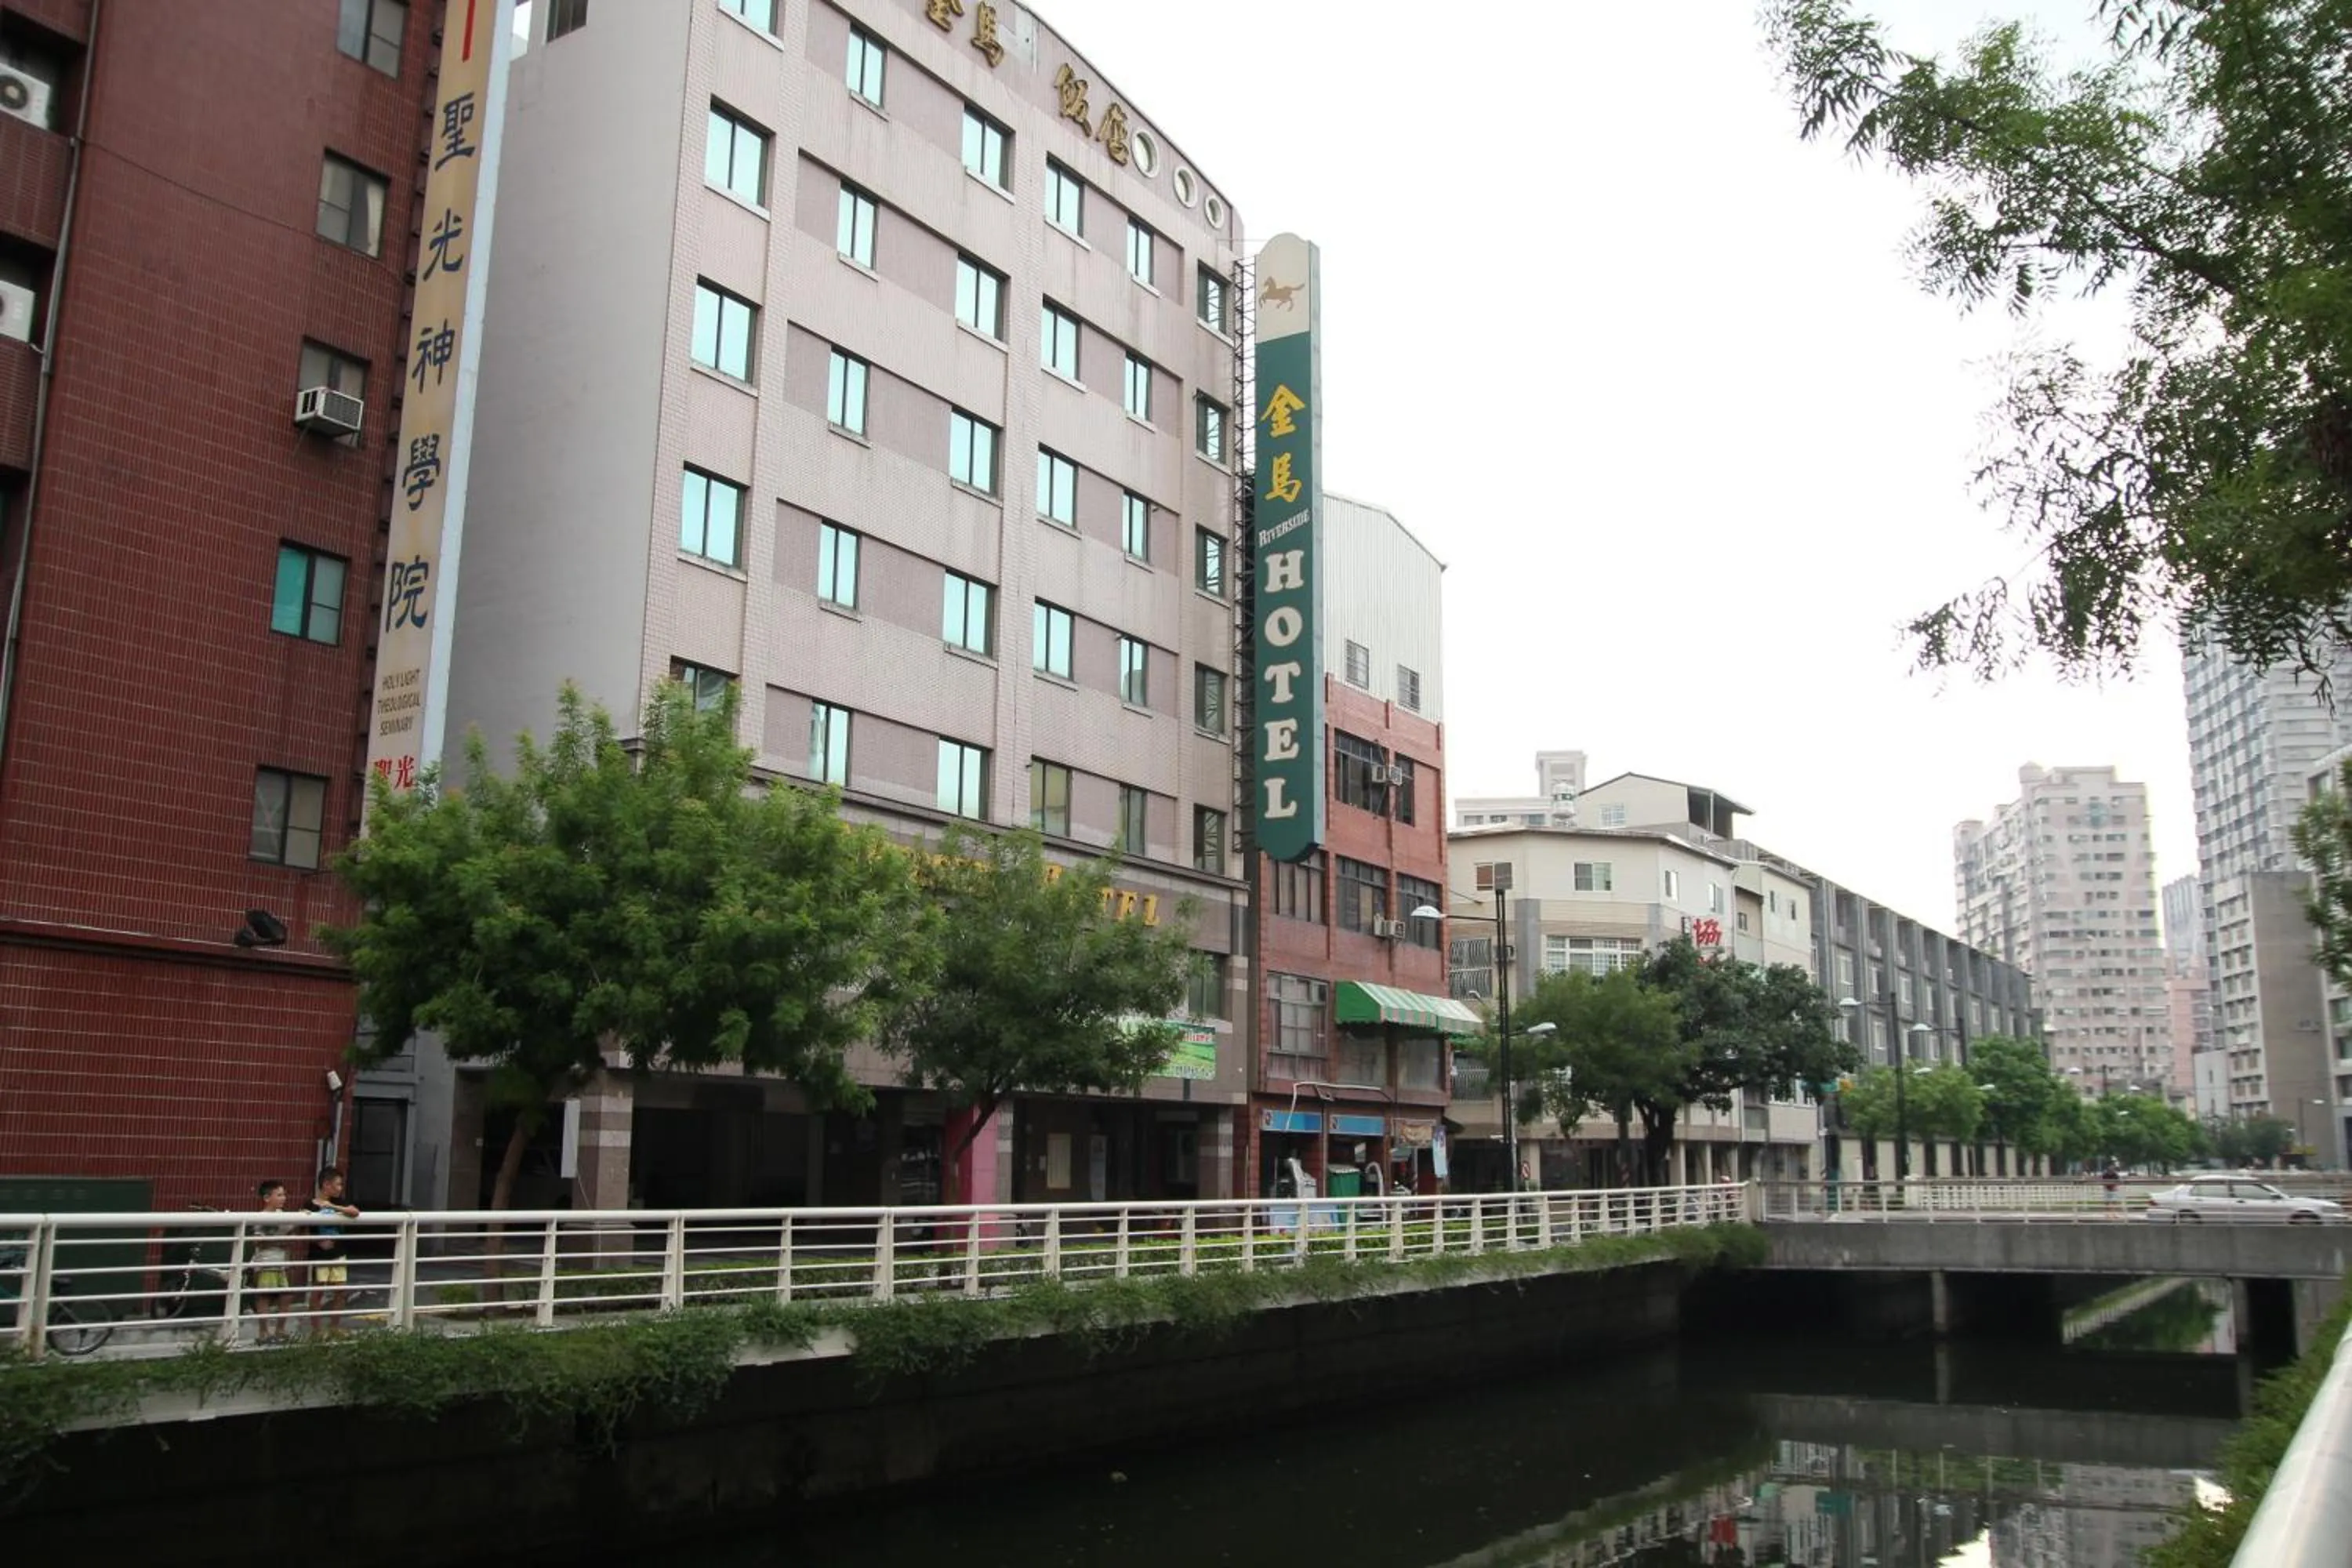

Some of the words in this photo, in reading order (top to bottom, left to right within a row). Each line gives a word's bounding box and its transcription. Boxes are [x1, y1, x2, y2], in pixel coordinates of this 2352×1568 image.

[385, 91, 476, 634] 聖光神學院
[1260, 383, 1306, 503] 金馬
[1258, 508, 1311, 548] RIVERSIDE
[383, 673, 400, 691] HOLY
[400, 669, 421, 688] LIGHT
[1263, 549, 1305, 819] HOTEL
[377, 692, 421, 715] THEOLOGICAL
[379, 717, 415, 736] SEMINARY
